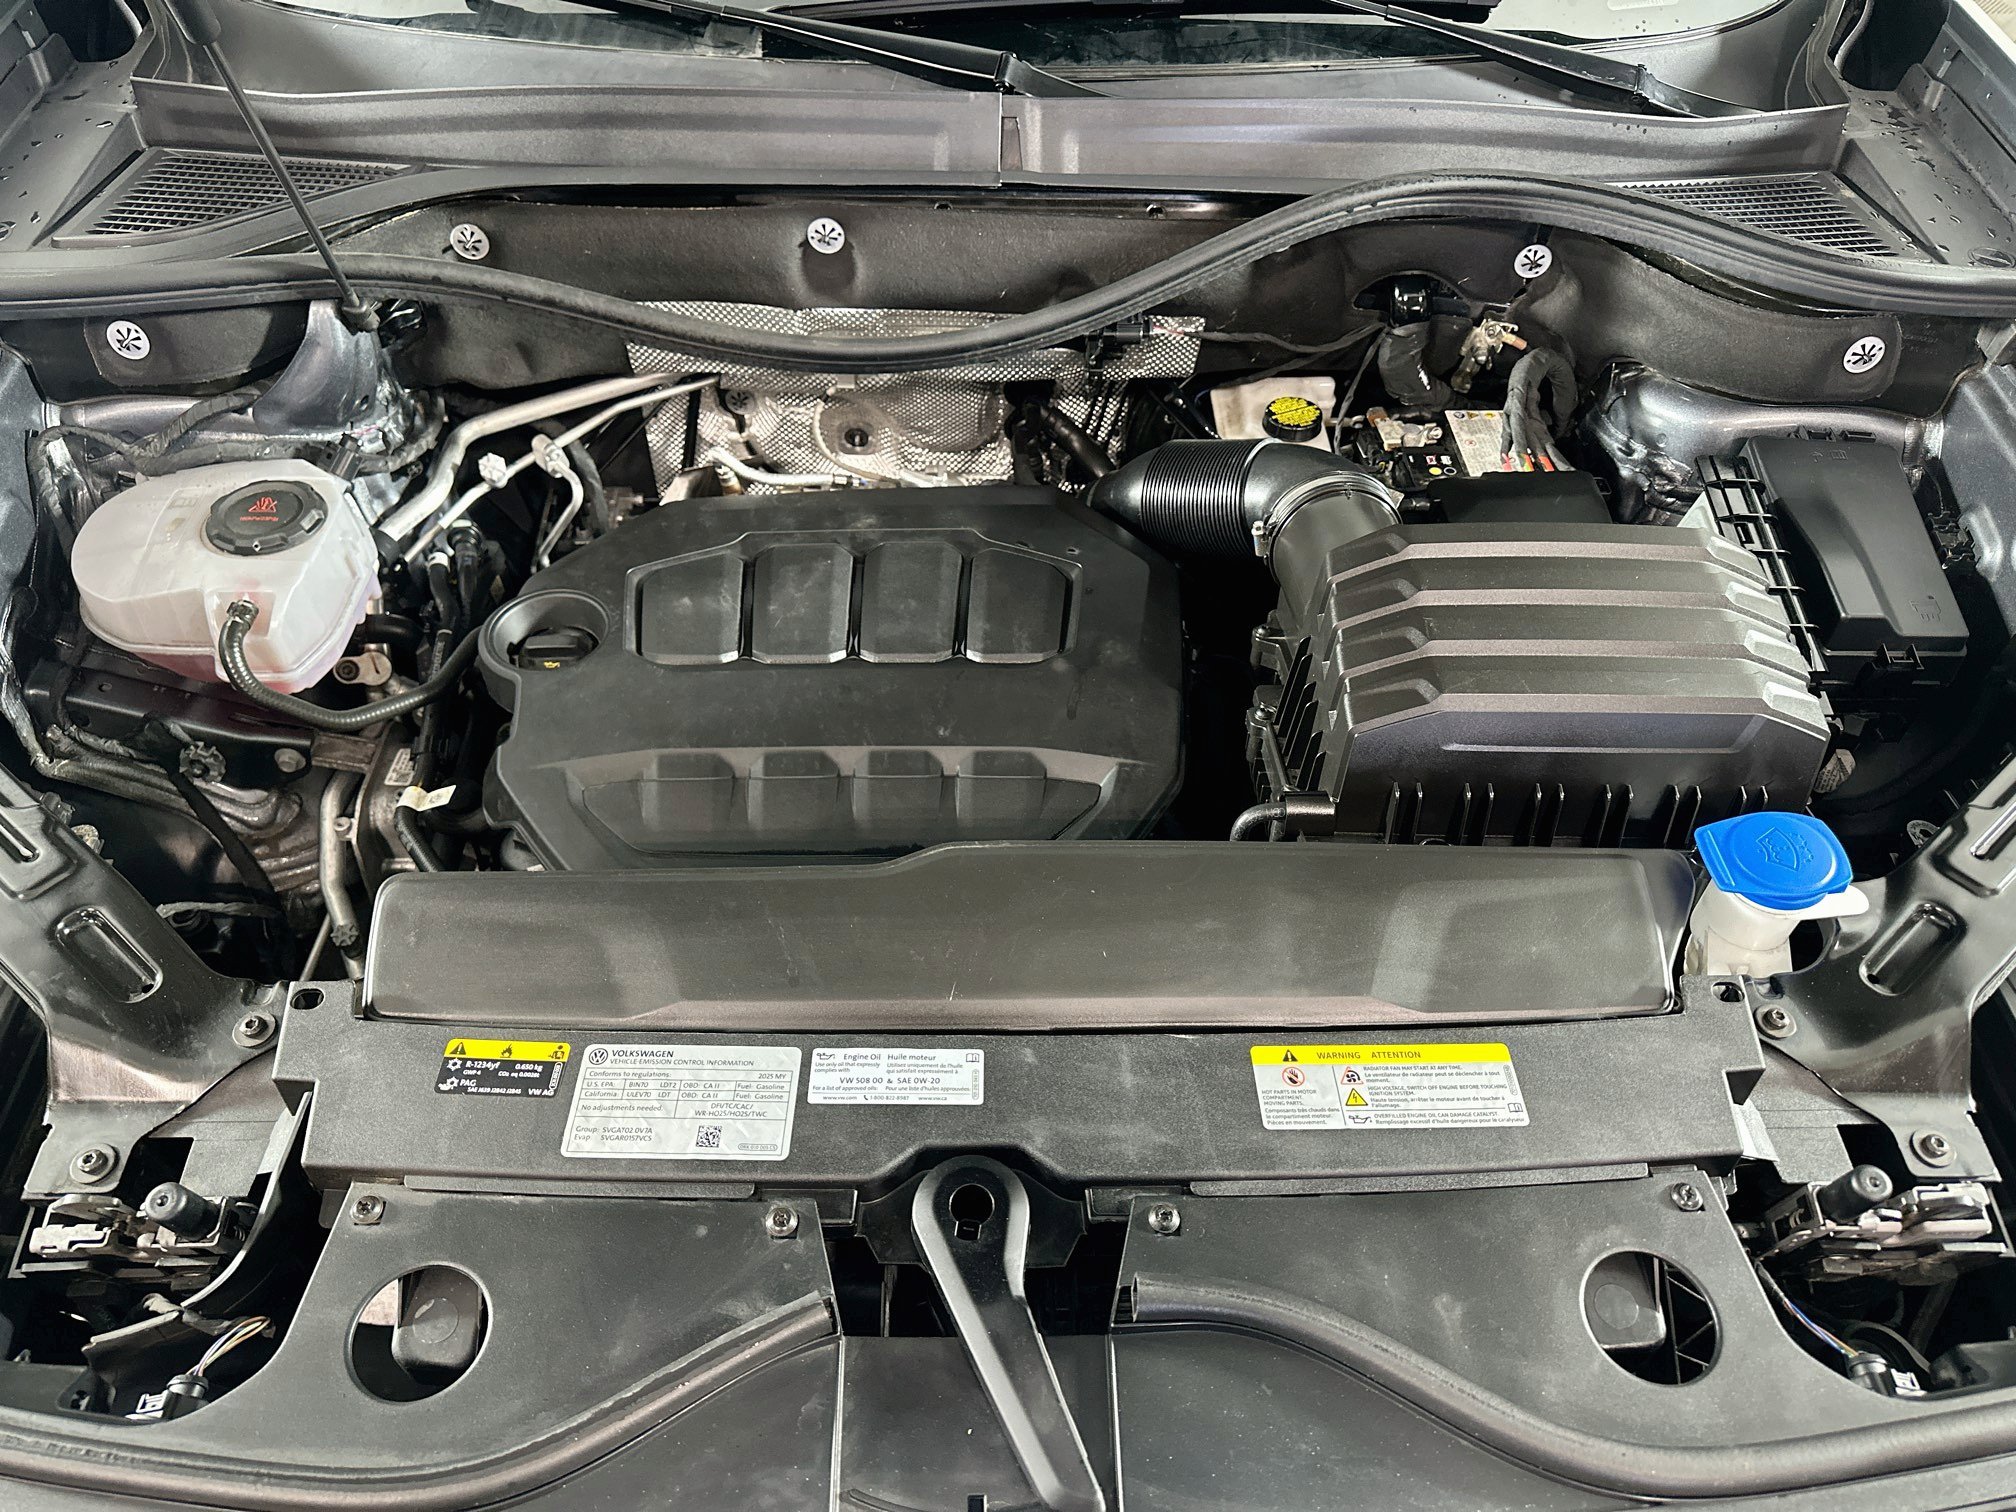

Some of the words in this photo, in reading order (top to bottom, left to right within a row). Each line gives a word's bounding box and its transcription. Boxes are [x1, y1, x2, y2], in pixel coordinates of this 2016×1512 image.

[466, 1061, 500, 1070] R-1234yf
[534, 1064, 543, 1072] kg
[460, 1079, 477, 1087] PAG
[528, 1088, 542, 1096] VW
